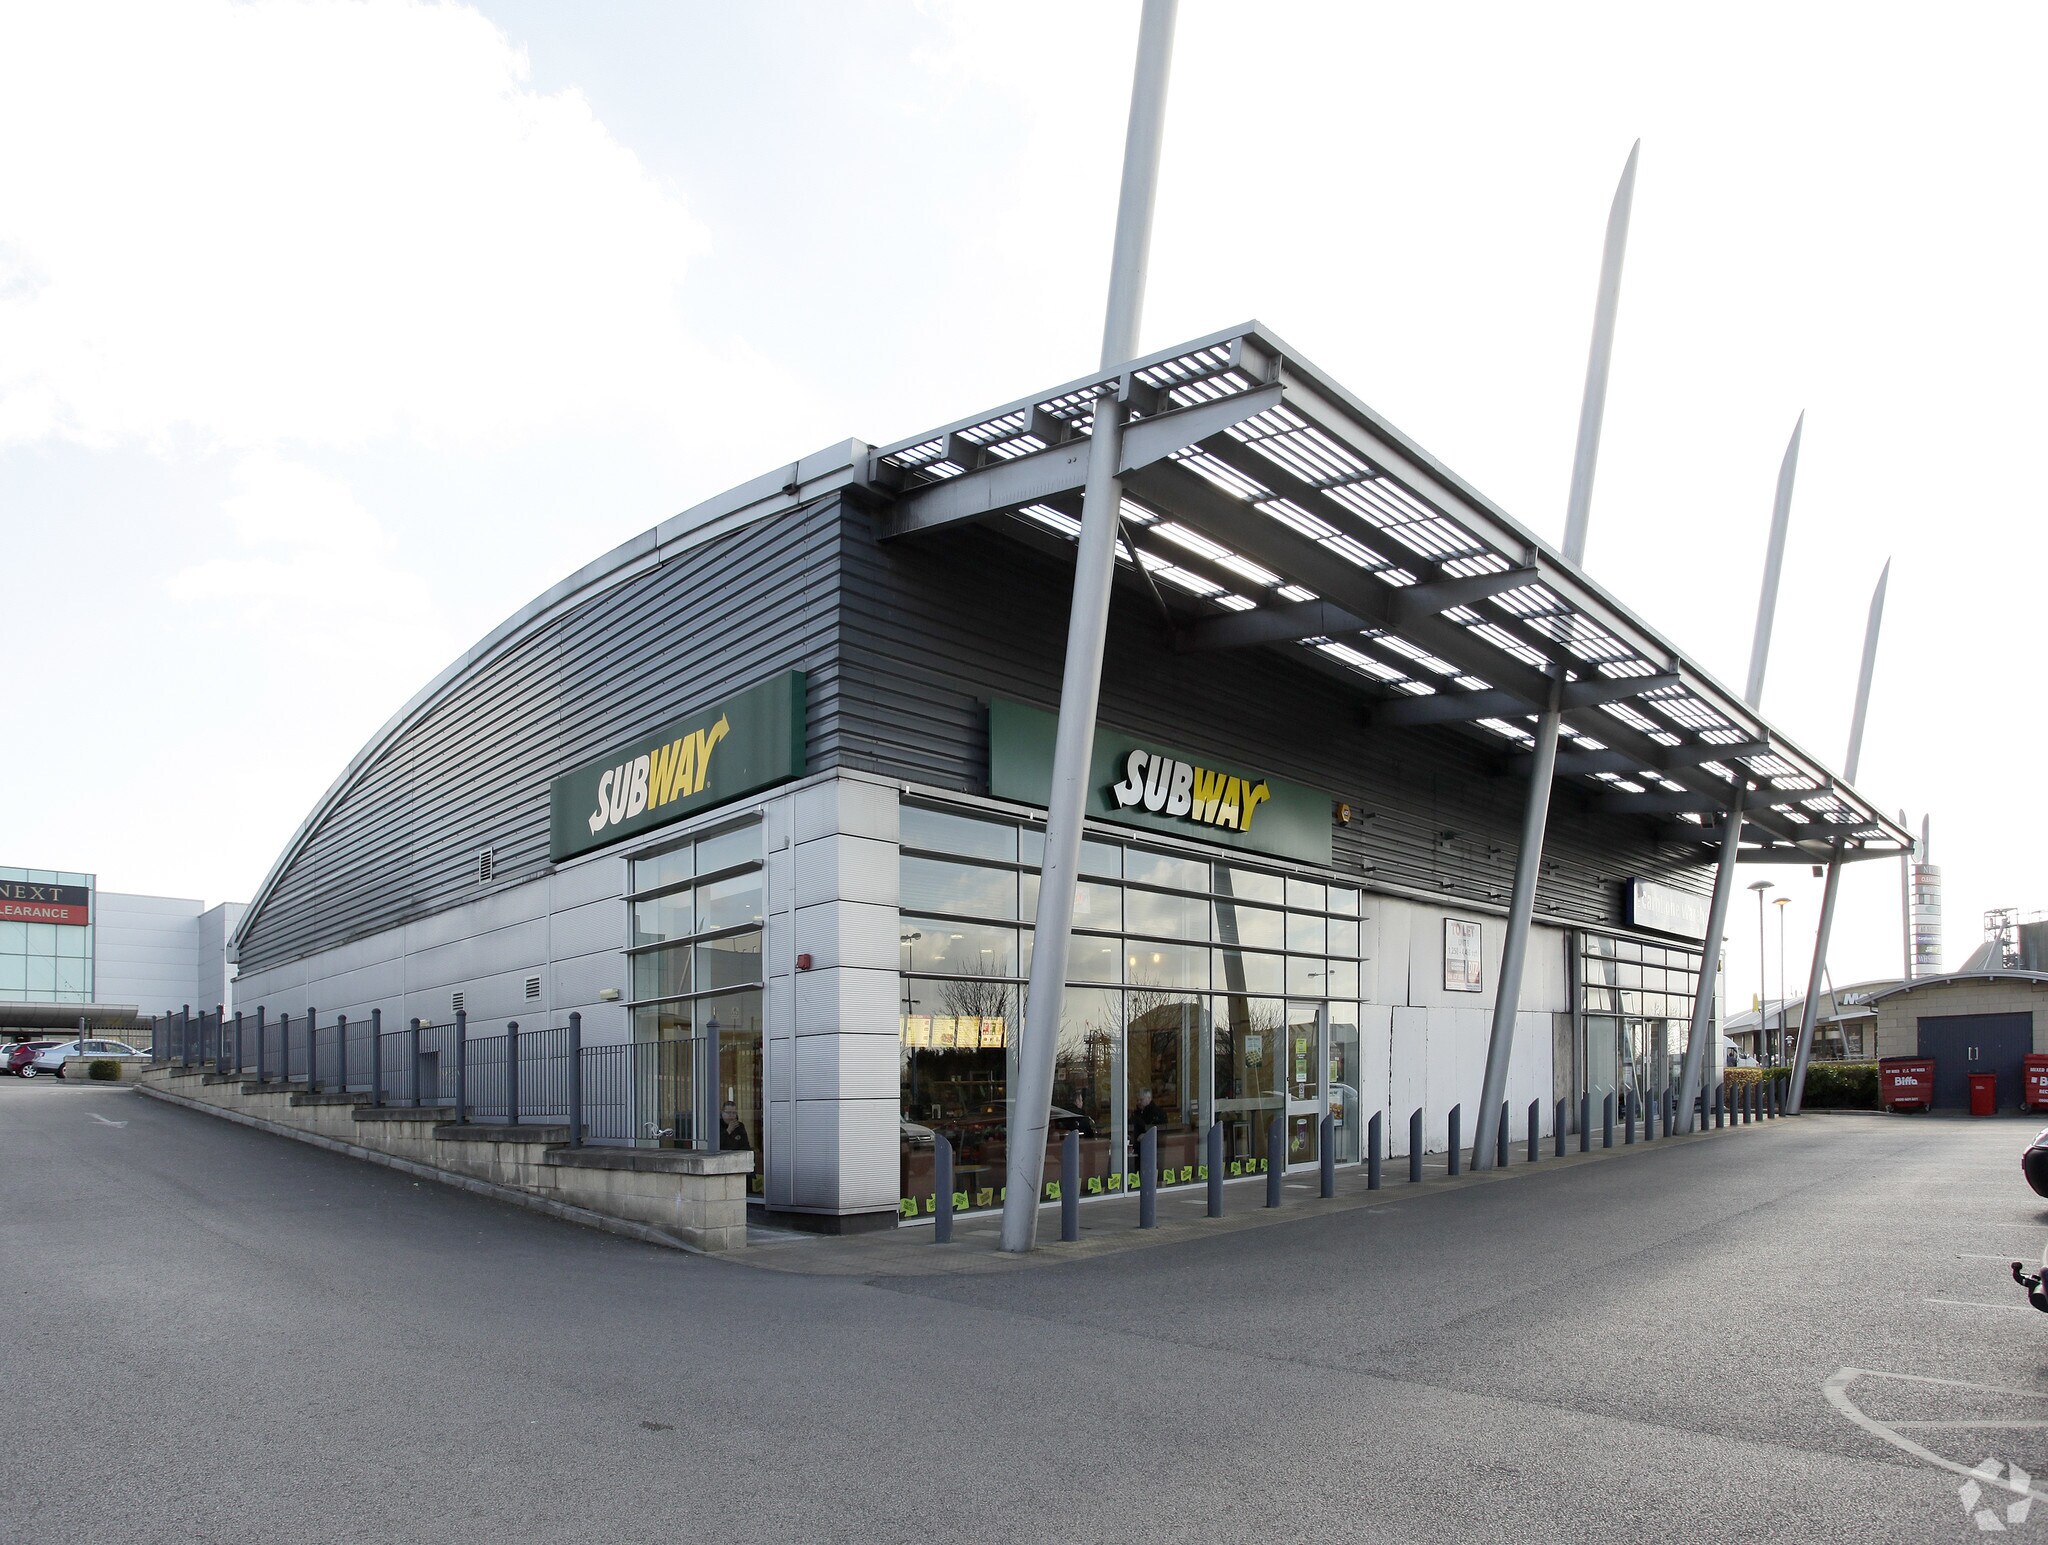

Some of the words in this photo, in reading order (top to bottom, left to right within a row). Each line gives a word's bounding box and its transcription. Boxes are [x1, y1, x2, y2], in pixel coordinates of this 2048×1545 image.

[588, 712, 730, 836] SUBWAY
[1113, 749, 1271, 832] SUBWAY
[0, 884, 63, 902] NEXT
[1894, 1076, 1918, 1087] Biffa
